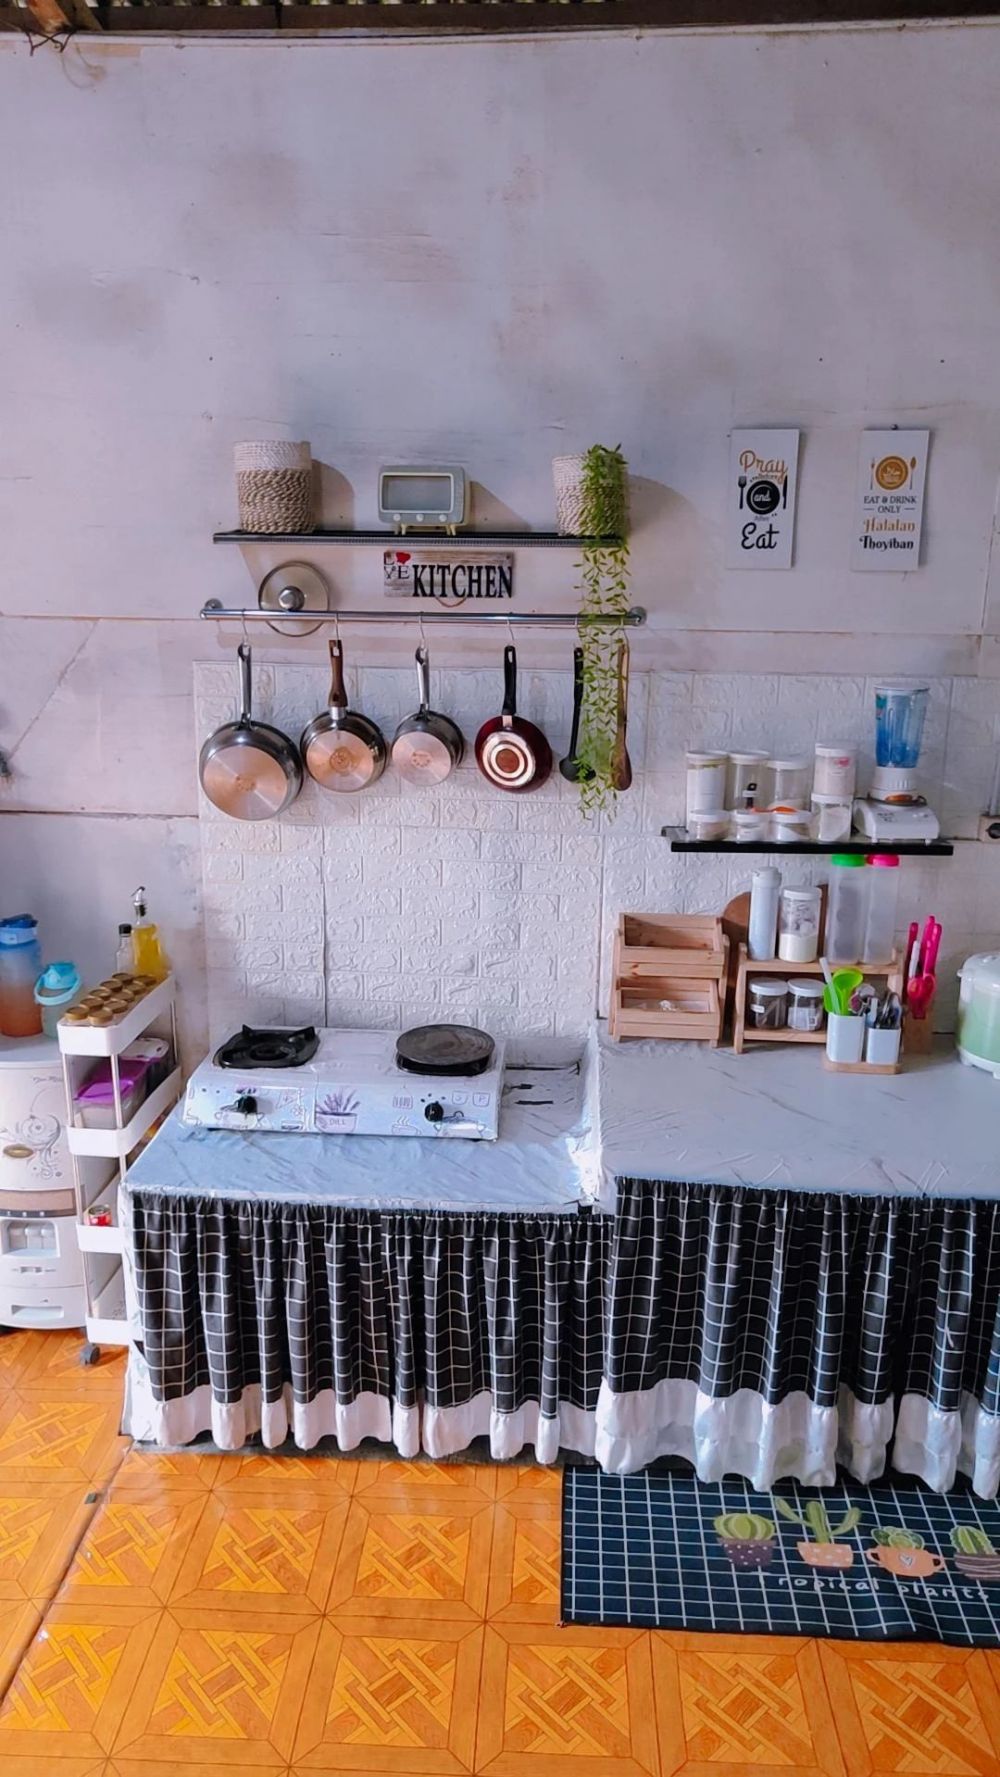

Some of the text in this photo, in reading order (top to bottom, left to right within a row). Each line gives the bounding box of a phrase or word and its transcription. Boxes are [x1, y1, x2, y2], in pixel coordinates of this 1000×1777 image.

[739, 449, 788, 485] Pray
[863, 495, 880, 504] EAT
[889, 495, 917, 504] DRINK
[877, 505, 901, 514] ONLY
[863, 517, 915, 534] Halalan
[741, 522, 780, 550] Eat
[859, 535, 914, 552] Thoyiban
[411, 564, 513, 598] KITCHEN
